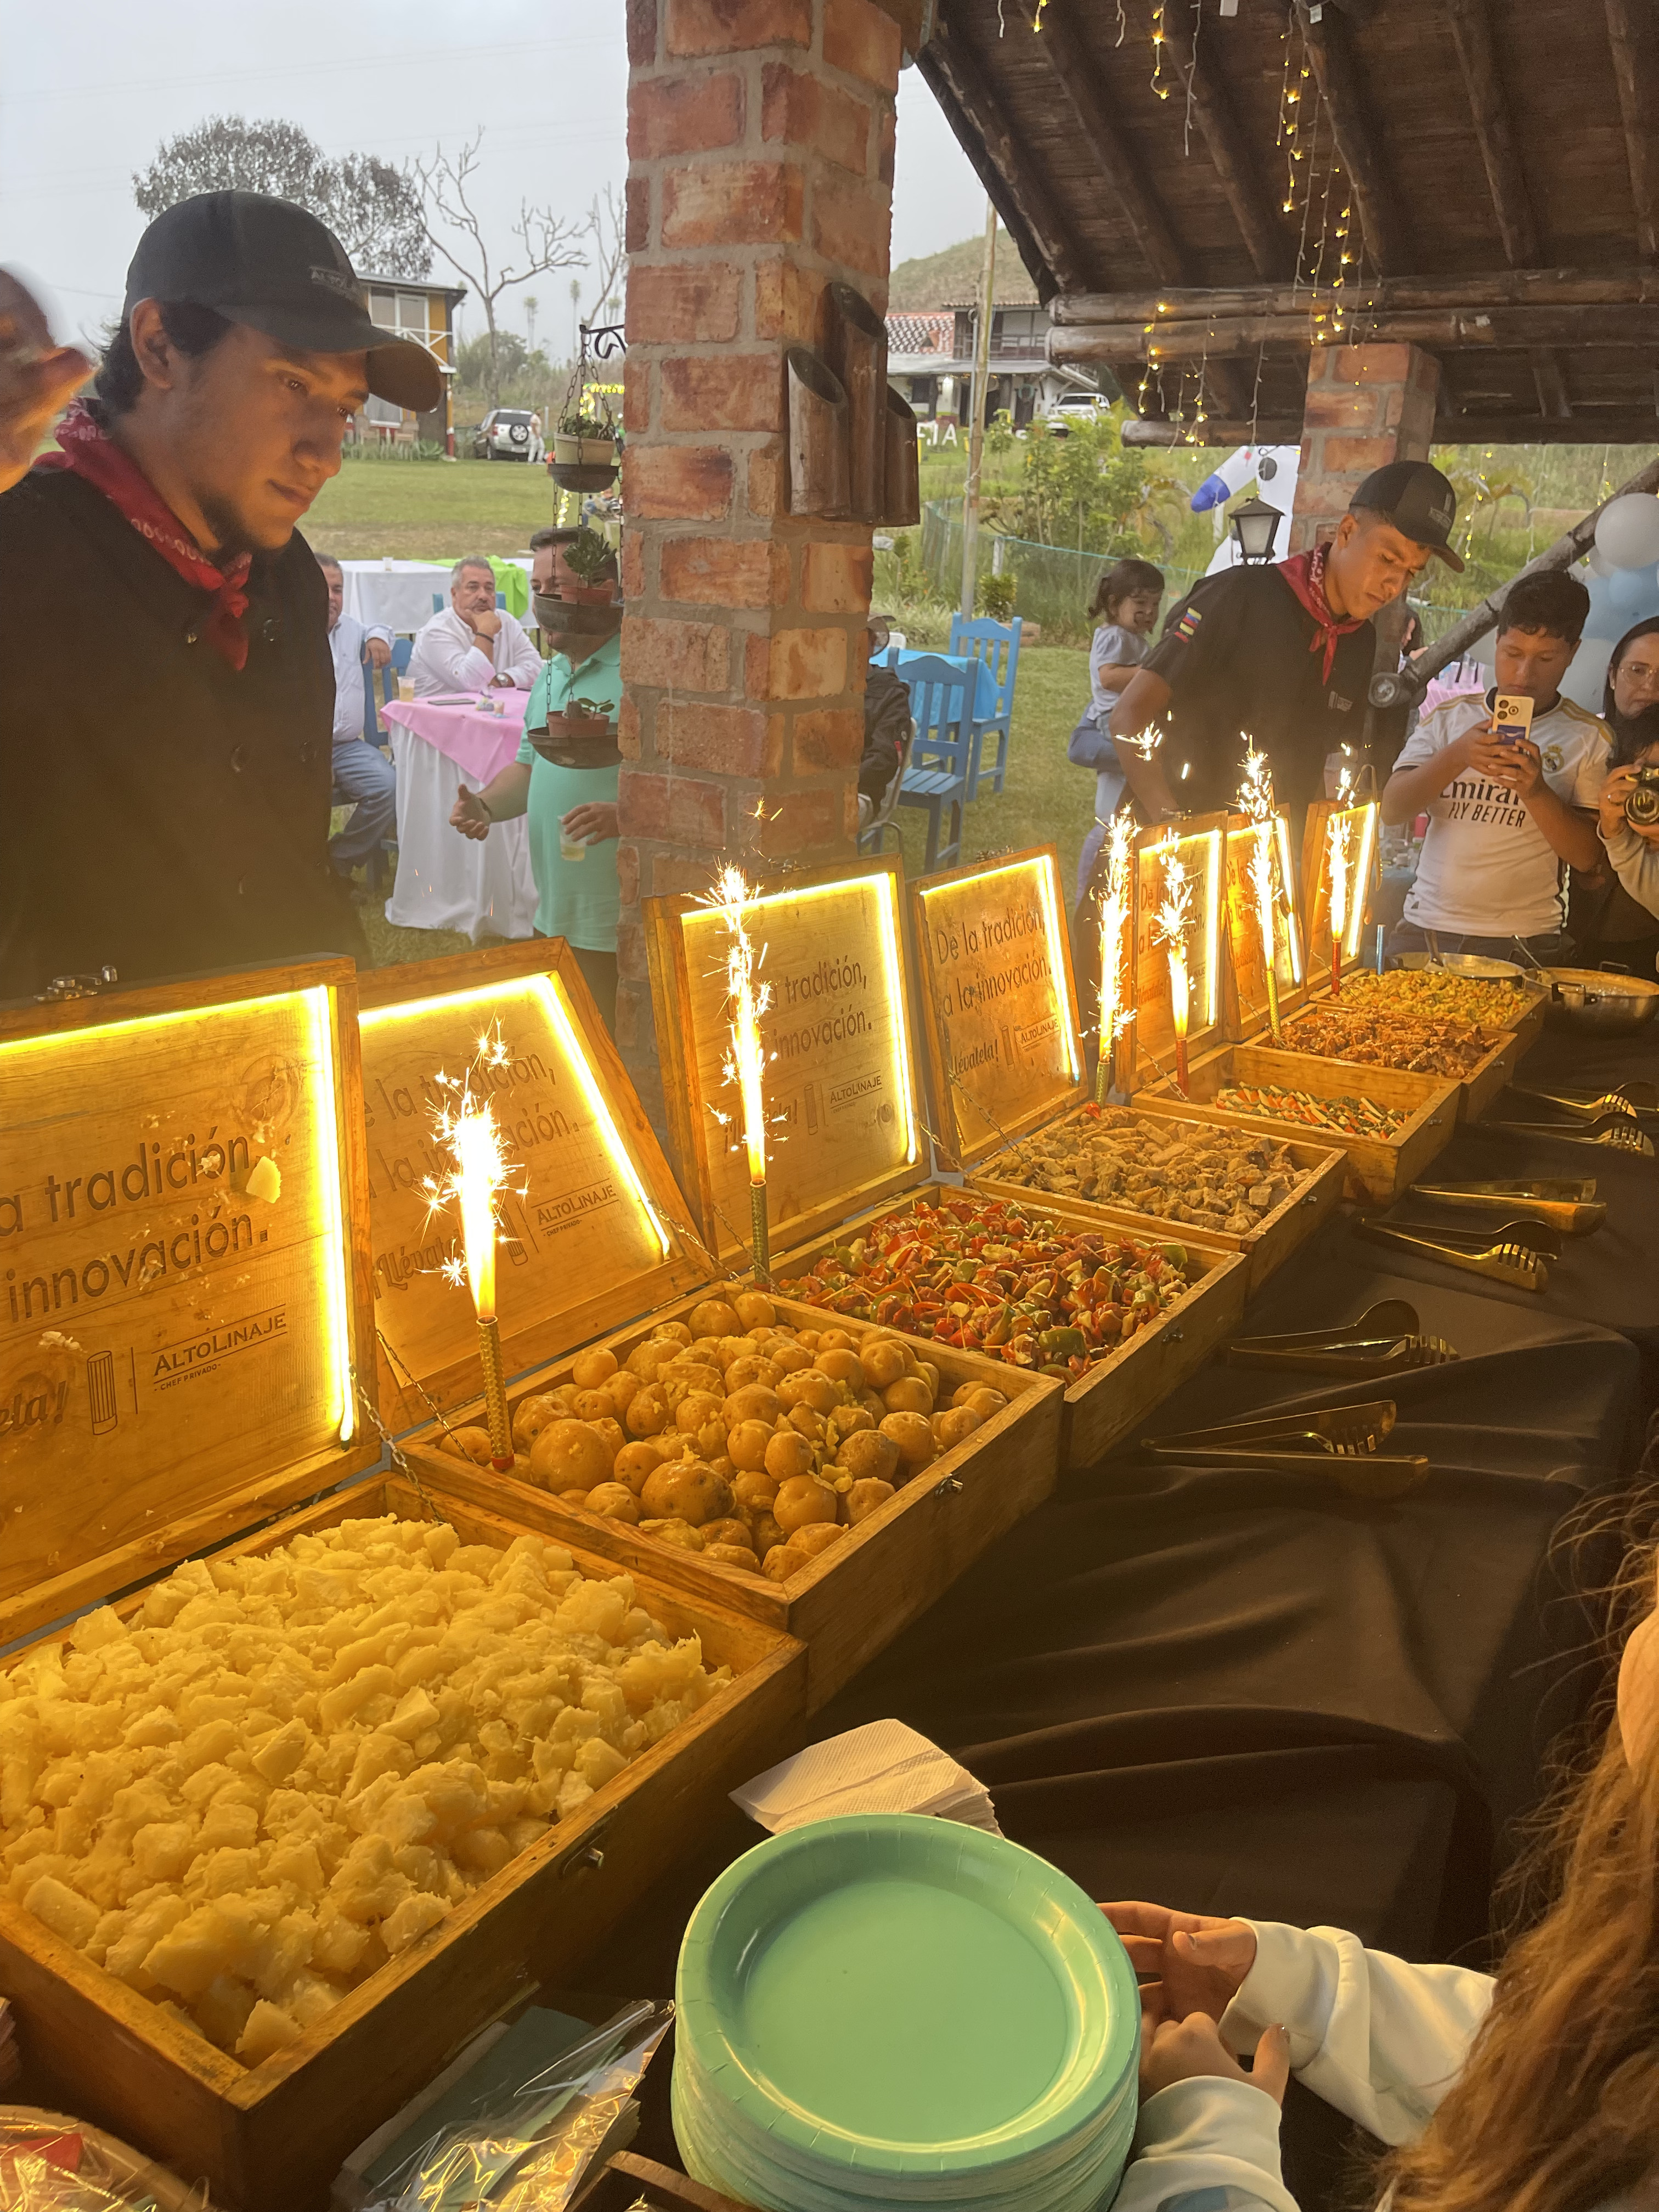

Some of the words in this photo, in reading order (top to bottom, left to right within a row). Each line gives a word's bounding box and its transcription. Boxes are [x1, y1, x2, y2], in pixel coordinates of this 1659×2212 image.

[1448, 802, 1470, 820] FLY
[1471, 804, 1526, 828] BETTER
[936, 930, 959, 965] De
[962, 922, 979, 956] la
[785, 955, 866, 1004] tradición,
[943, 994, 953, 1017] a
[957, 978, 973, 1011] la
[976, 950, 1052, 1003] innovación.
[774, 1004, 872, 1060] innovación.
[375, 1079, 418, 1120] la
[830, 1075, 882, 1104] ALTOLINAJE
[375, 1149, 419, 1192] la
[537, 1184, 617, 1226] ALTOLINAJE
[6, 1205, 268, 1323] innovación.
[154, 1312, 286, 1377] ALTOLINAJE
[160, 1377, 182, 1391] CHEF
[183, 1364, 217, 1381] PRIVADO
